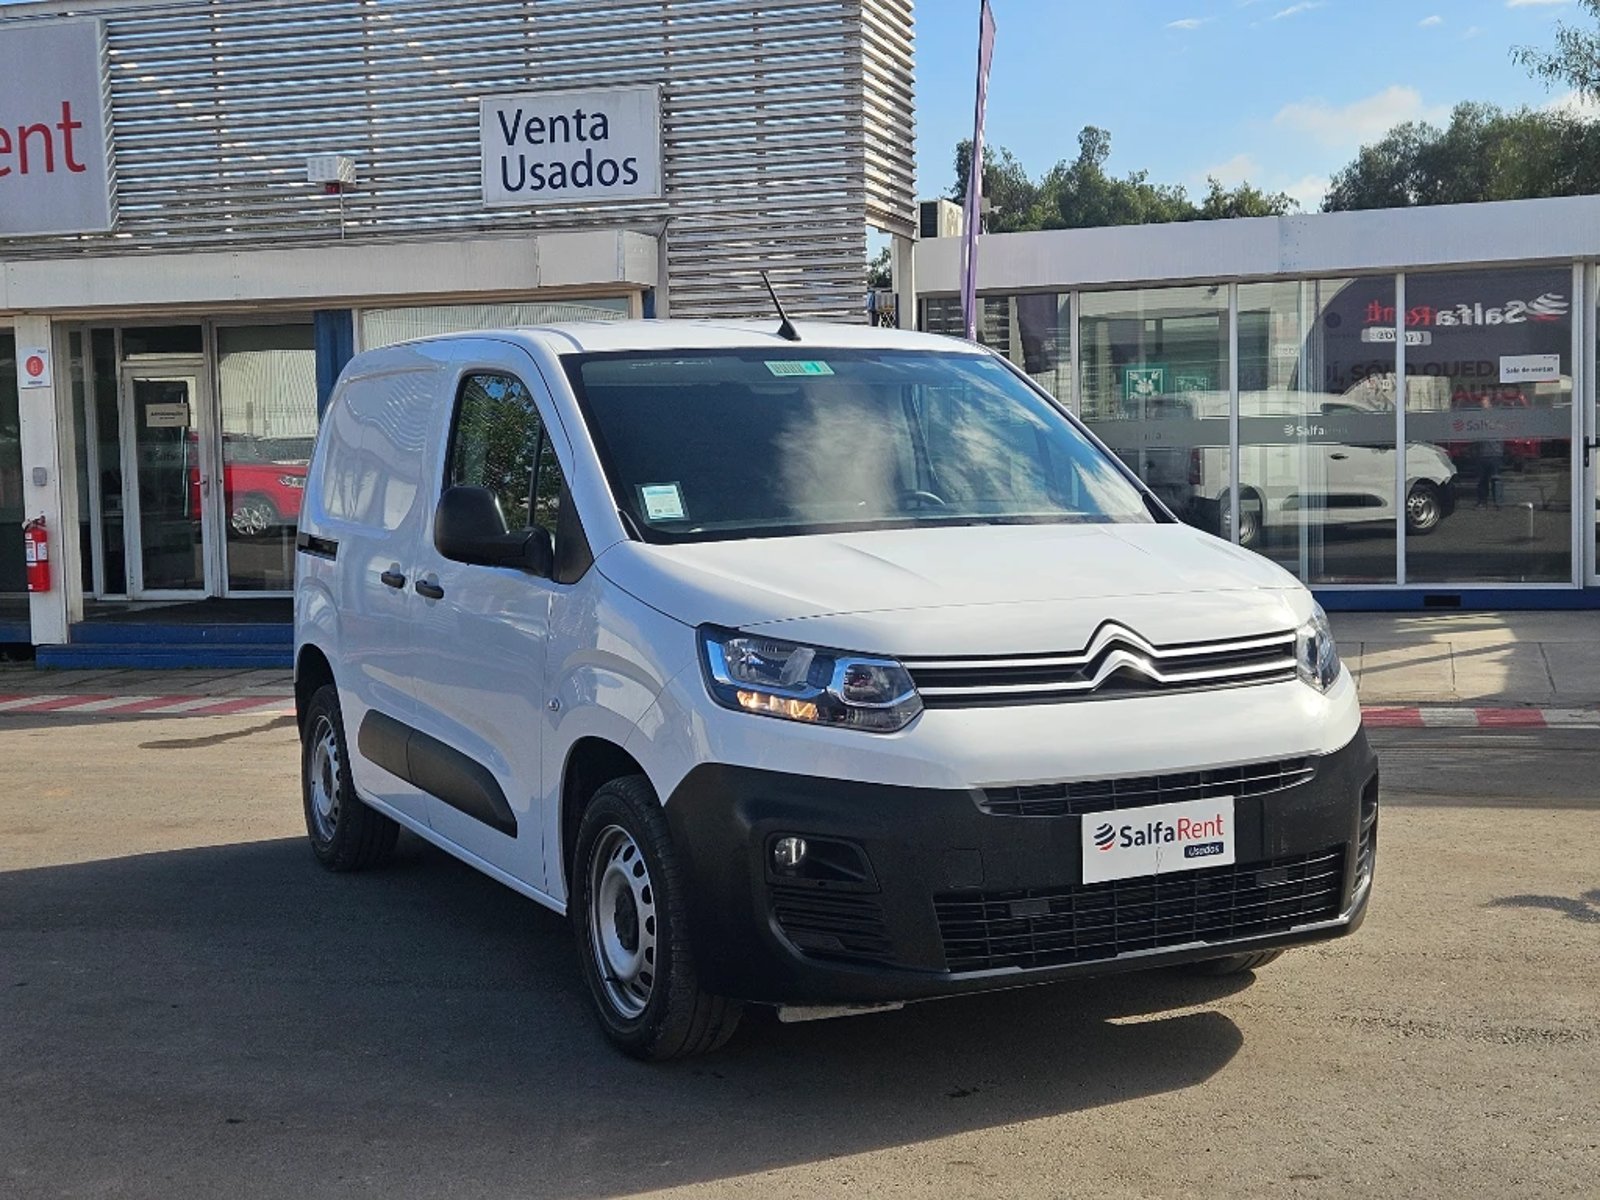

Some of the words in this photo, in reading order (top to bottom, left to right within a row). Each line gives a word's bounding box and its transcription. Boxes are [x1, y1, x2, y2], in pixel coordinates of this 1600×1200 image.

[497, 109, 609, 146] Venta
[501, 148, 639, 192] Usados
[1119, 813, 1224, 848] SalfaRent
[1188, 844, 1220, 857] Usados
